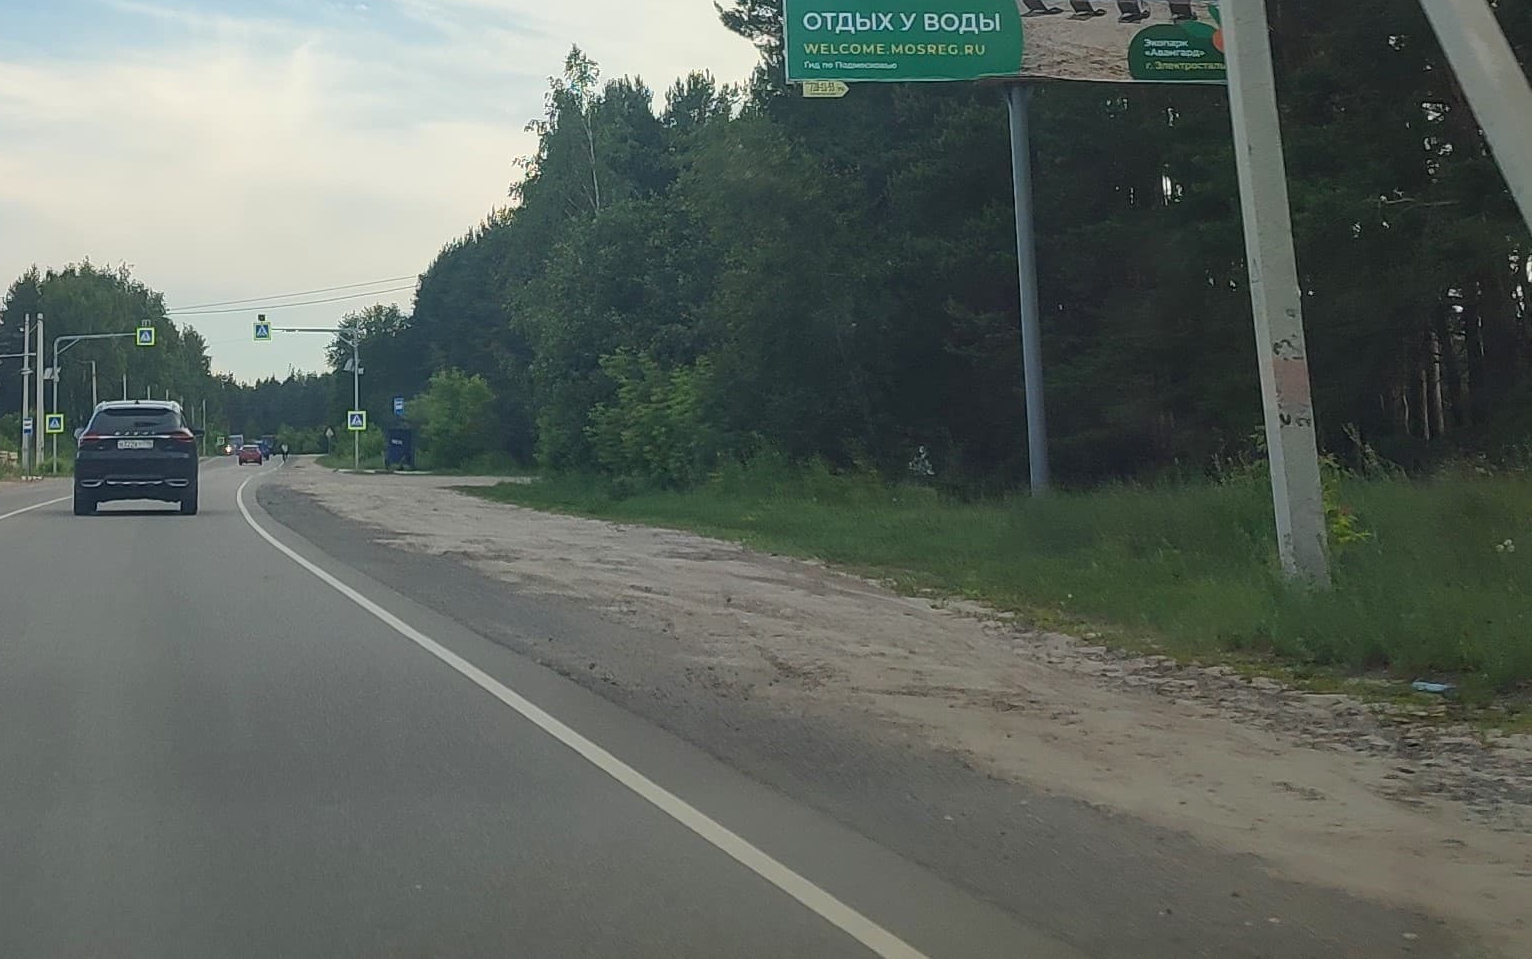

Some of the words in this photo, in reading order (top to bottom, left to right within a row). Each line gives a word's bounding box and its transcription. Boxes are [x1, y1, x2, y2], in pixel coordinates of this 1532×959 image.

[802, 12, 895, 35] ОТДЫХ
[899, 12, 917, 31] У
[923, 12, 1001, 35] ВОДЫ
[803, 43, 986, 56] WELCOME.MOSREG.RU
